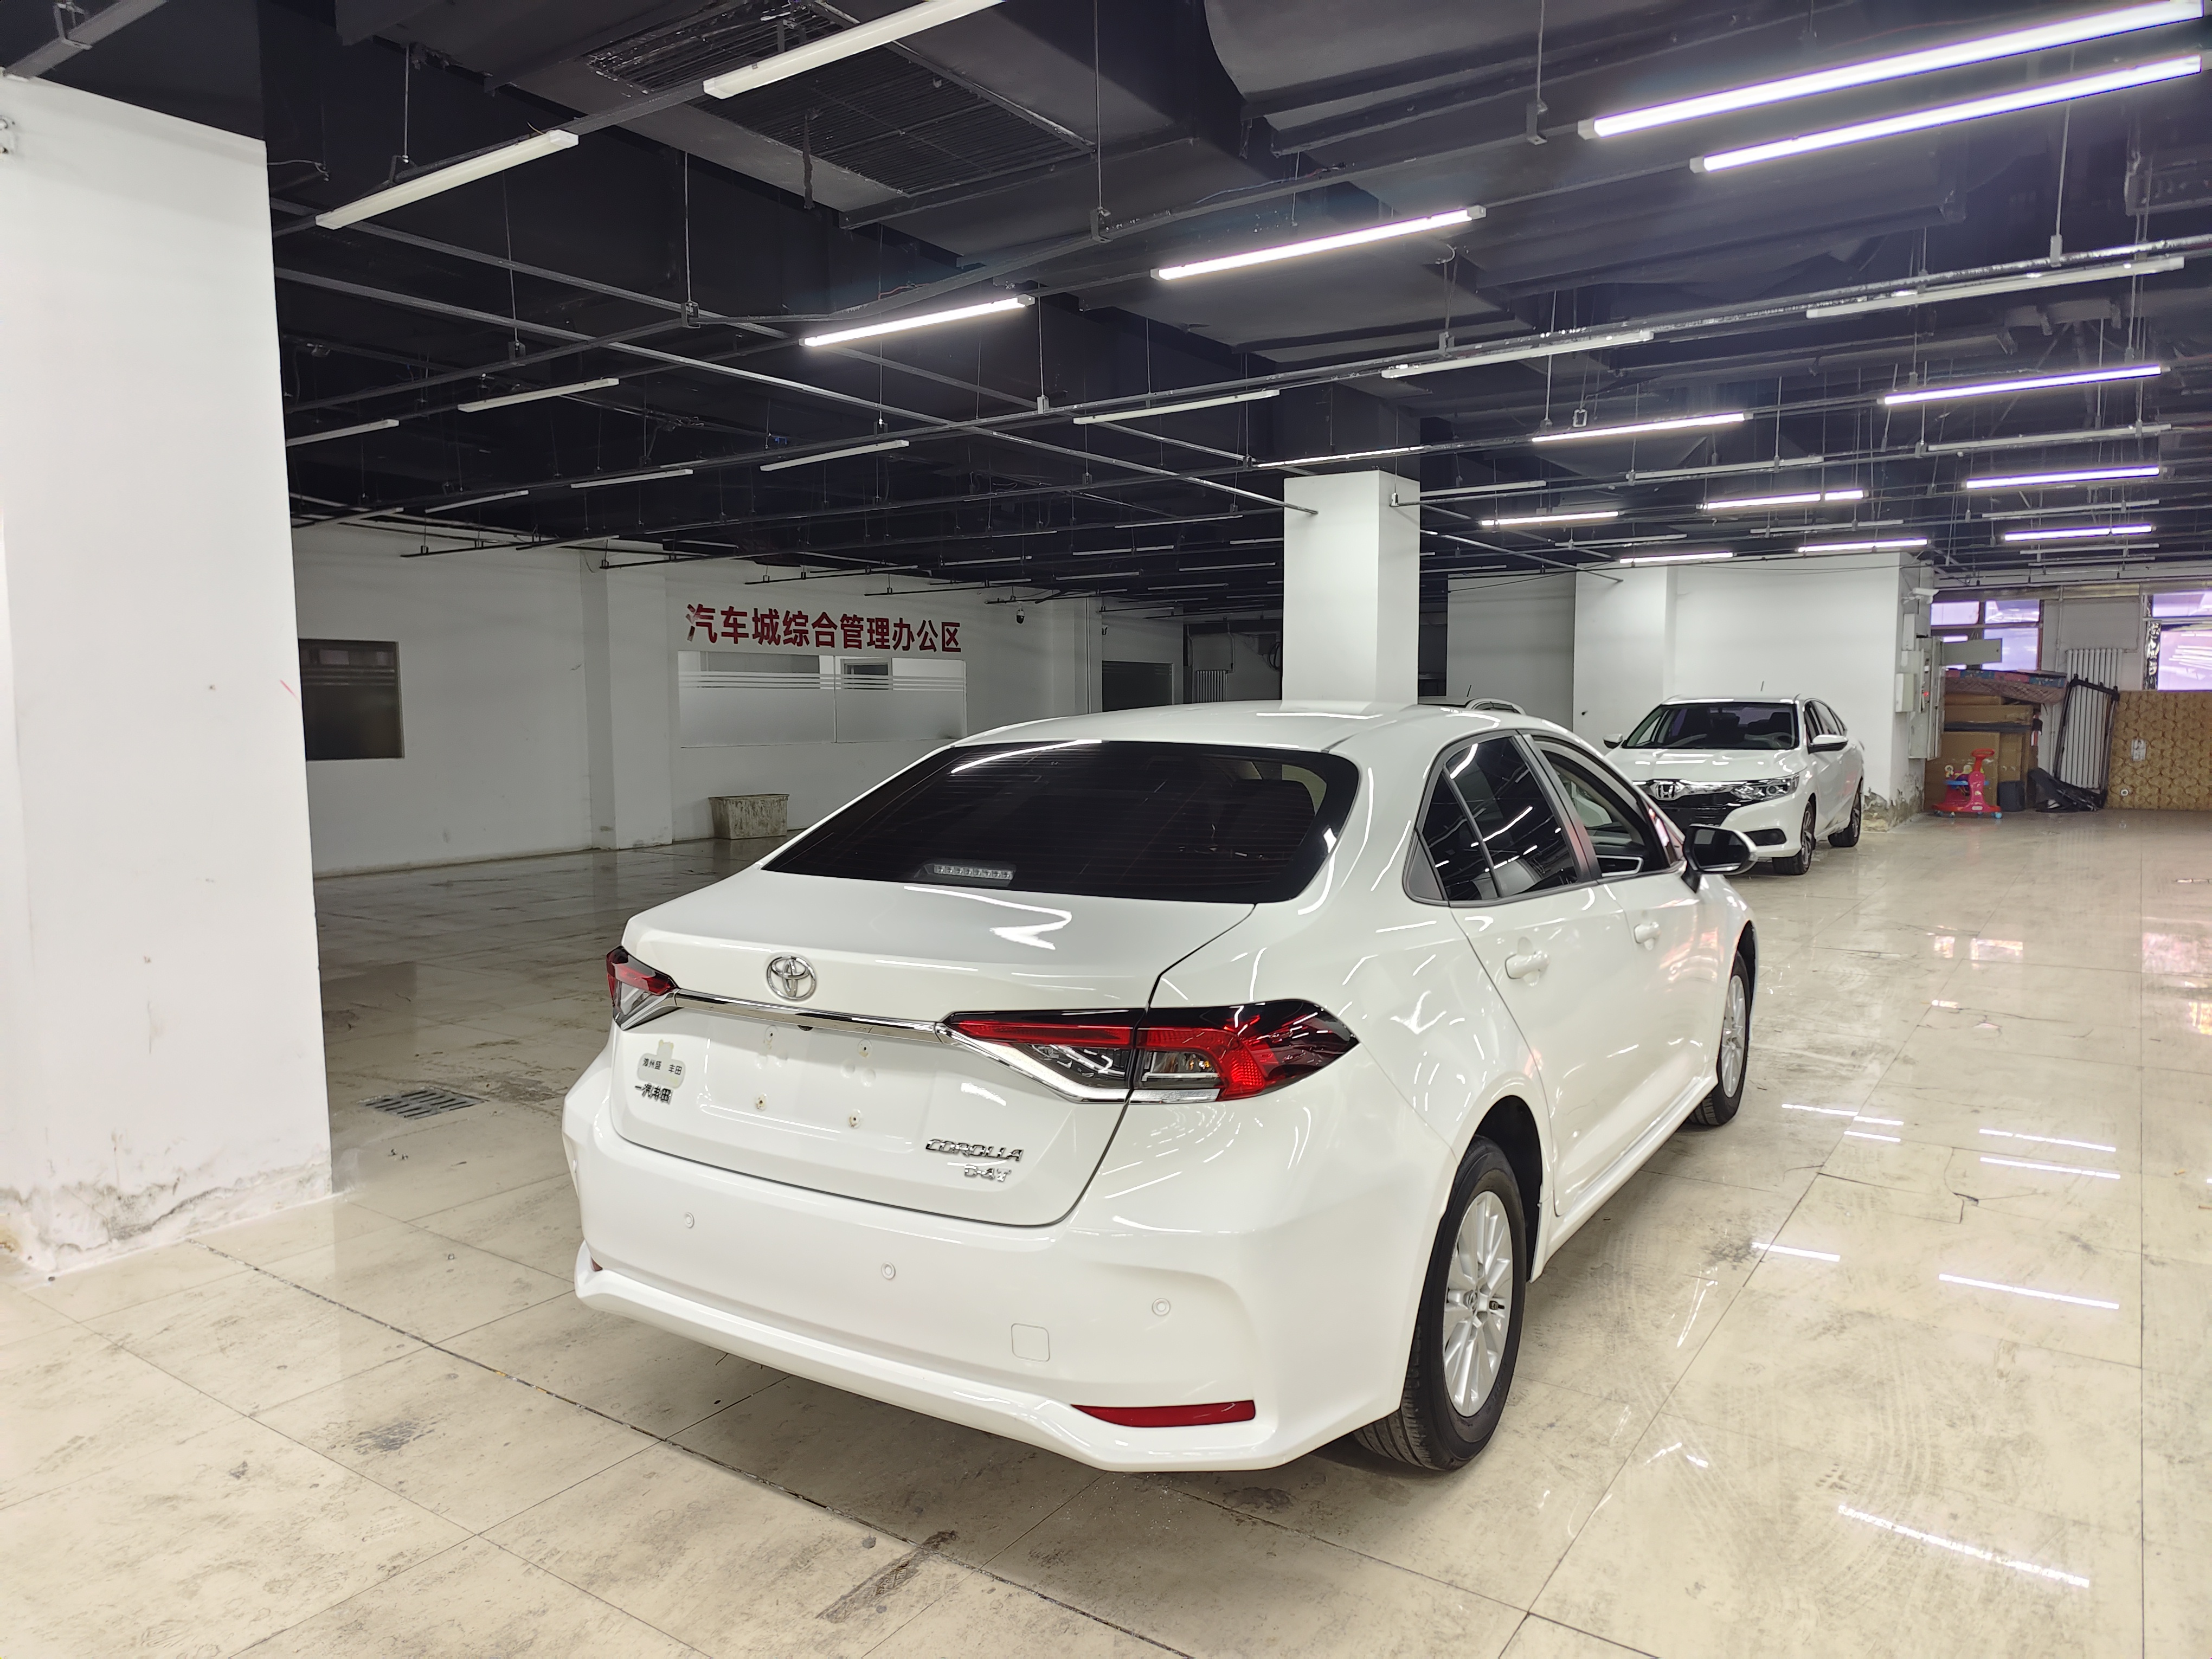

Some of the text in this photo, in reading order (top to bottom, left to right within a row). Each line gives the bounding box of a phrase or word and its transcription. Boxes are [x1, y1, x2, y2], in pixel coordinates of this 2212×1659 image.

[686, 603, 962, 653] 汽车城综合管理办公区
[668, 1064, 683, 1076] 丰田
[634, 1083, 673, 1104] 一汽丰田
[925, 1139, 1024, 1161] COROLLA
